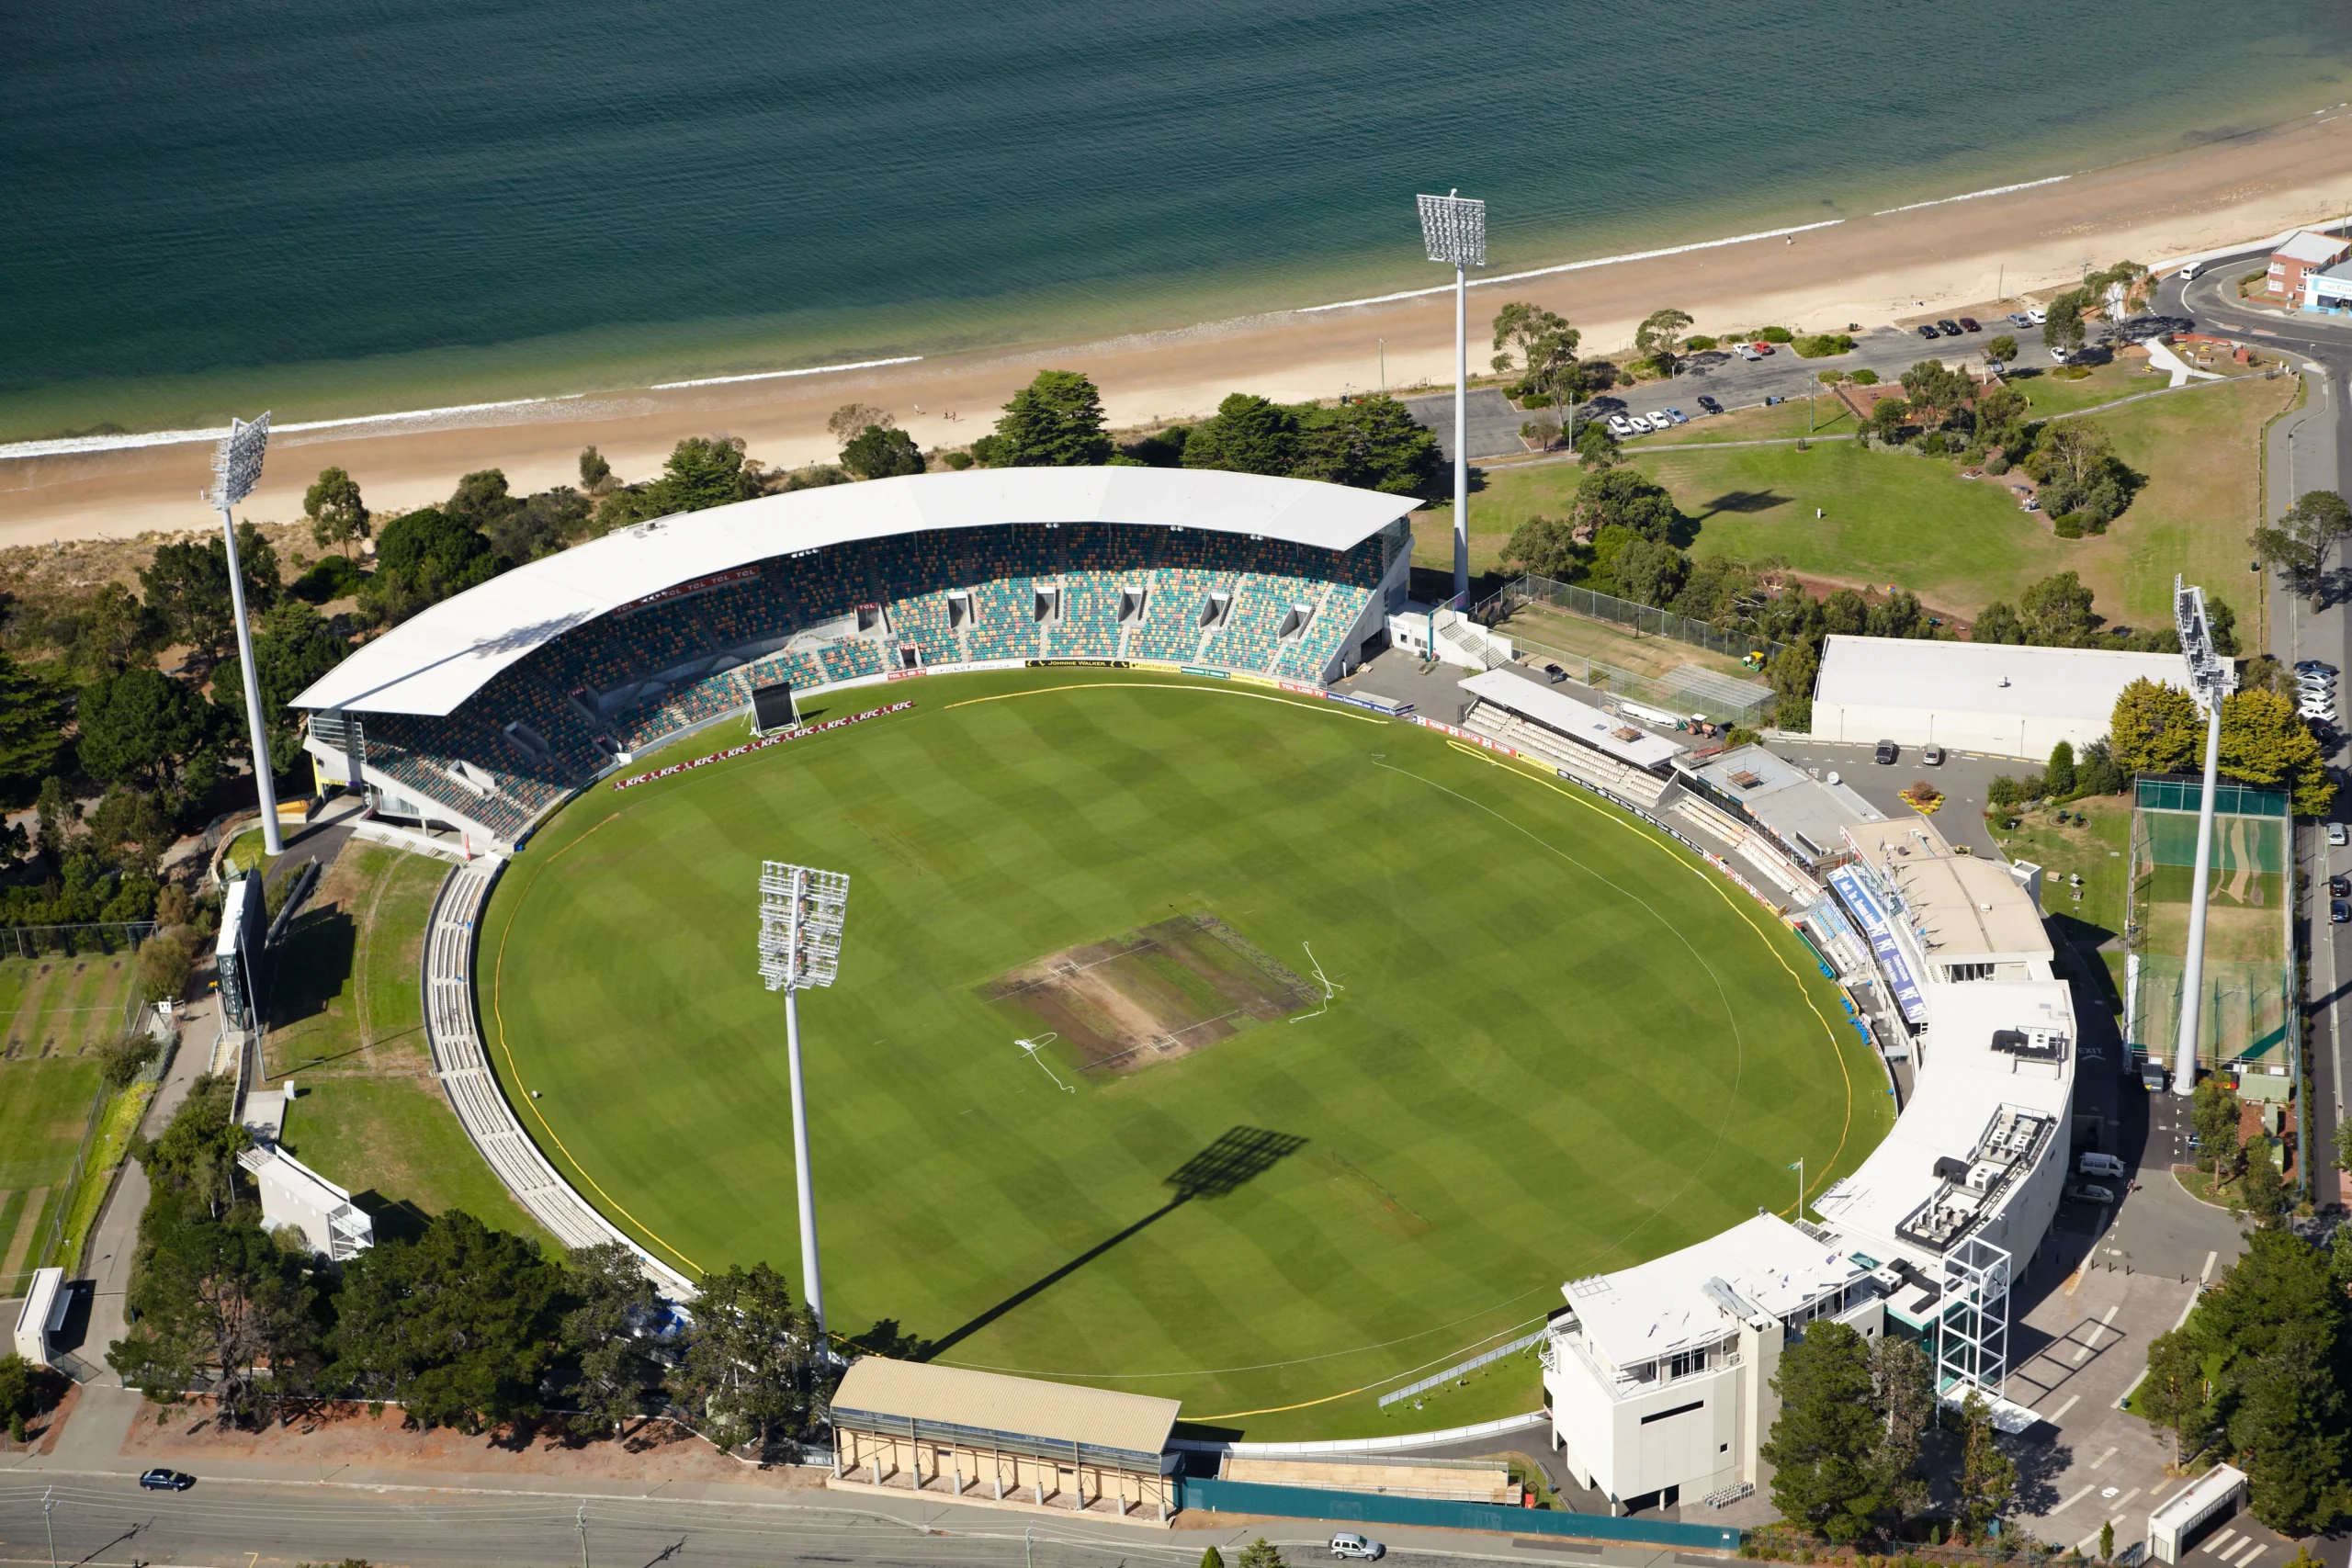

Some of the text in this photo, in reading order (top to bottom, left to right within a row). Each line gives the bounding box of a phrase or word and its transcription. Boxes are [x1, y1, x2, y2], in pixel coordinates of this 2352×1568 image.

[735, 569, 756, 578] TCL
[711, 575, 730, 584] TCL
[687, 581, 707, 591] TCL
[616, 603, 634, 613] TCL
[917, 668, 927, 676] TV
[933, 663, 1011, 674] cricket.com.au
[1139, 663, 1181, 671] betfair.com
[571, 687, 585, 696] TCL
[1281, 682, 1296, 691] TCL
[1429, 719, 1510, 754] Mobile $29 Cap Mobile
[626, 701, 911, 787] KFC KFC KFC KFC KFC KFC KFC KFC KFC
[1523, 752, 1556, 773] betfair.com
[1867, 921, 1889, 937] PKF
[1875, 938, 1897, 953] PKF
[1898, 986, 1928, 1019] PKF PKF
